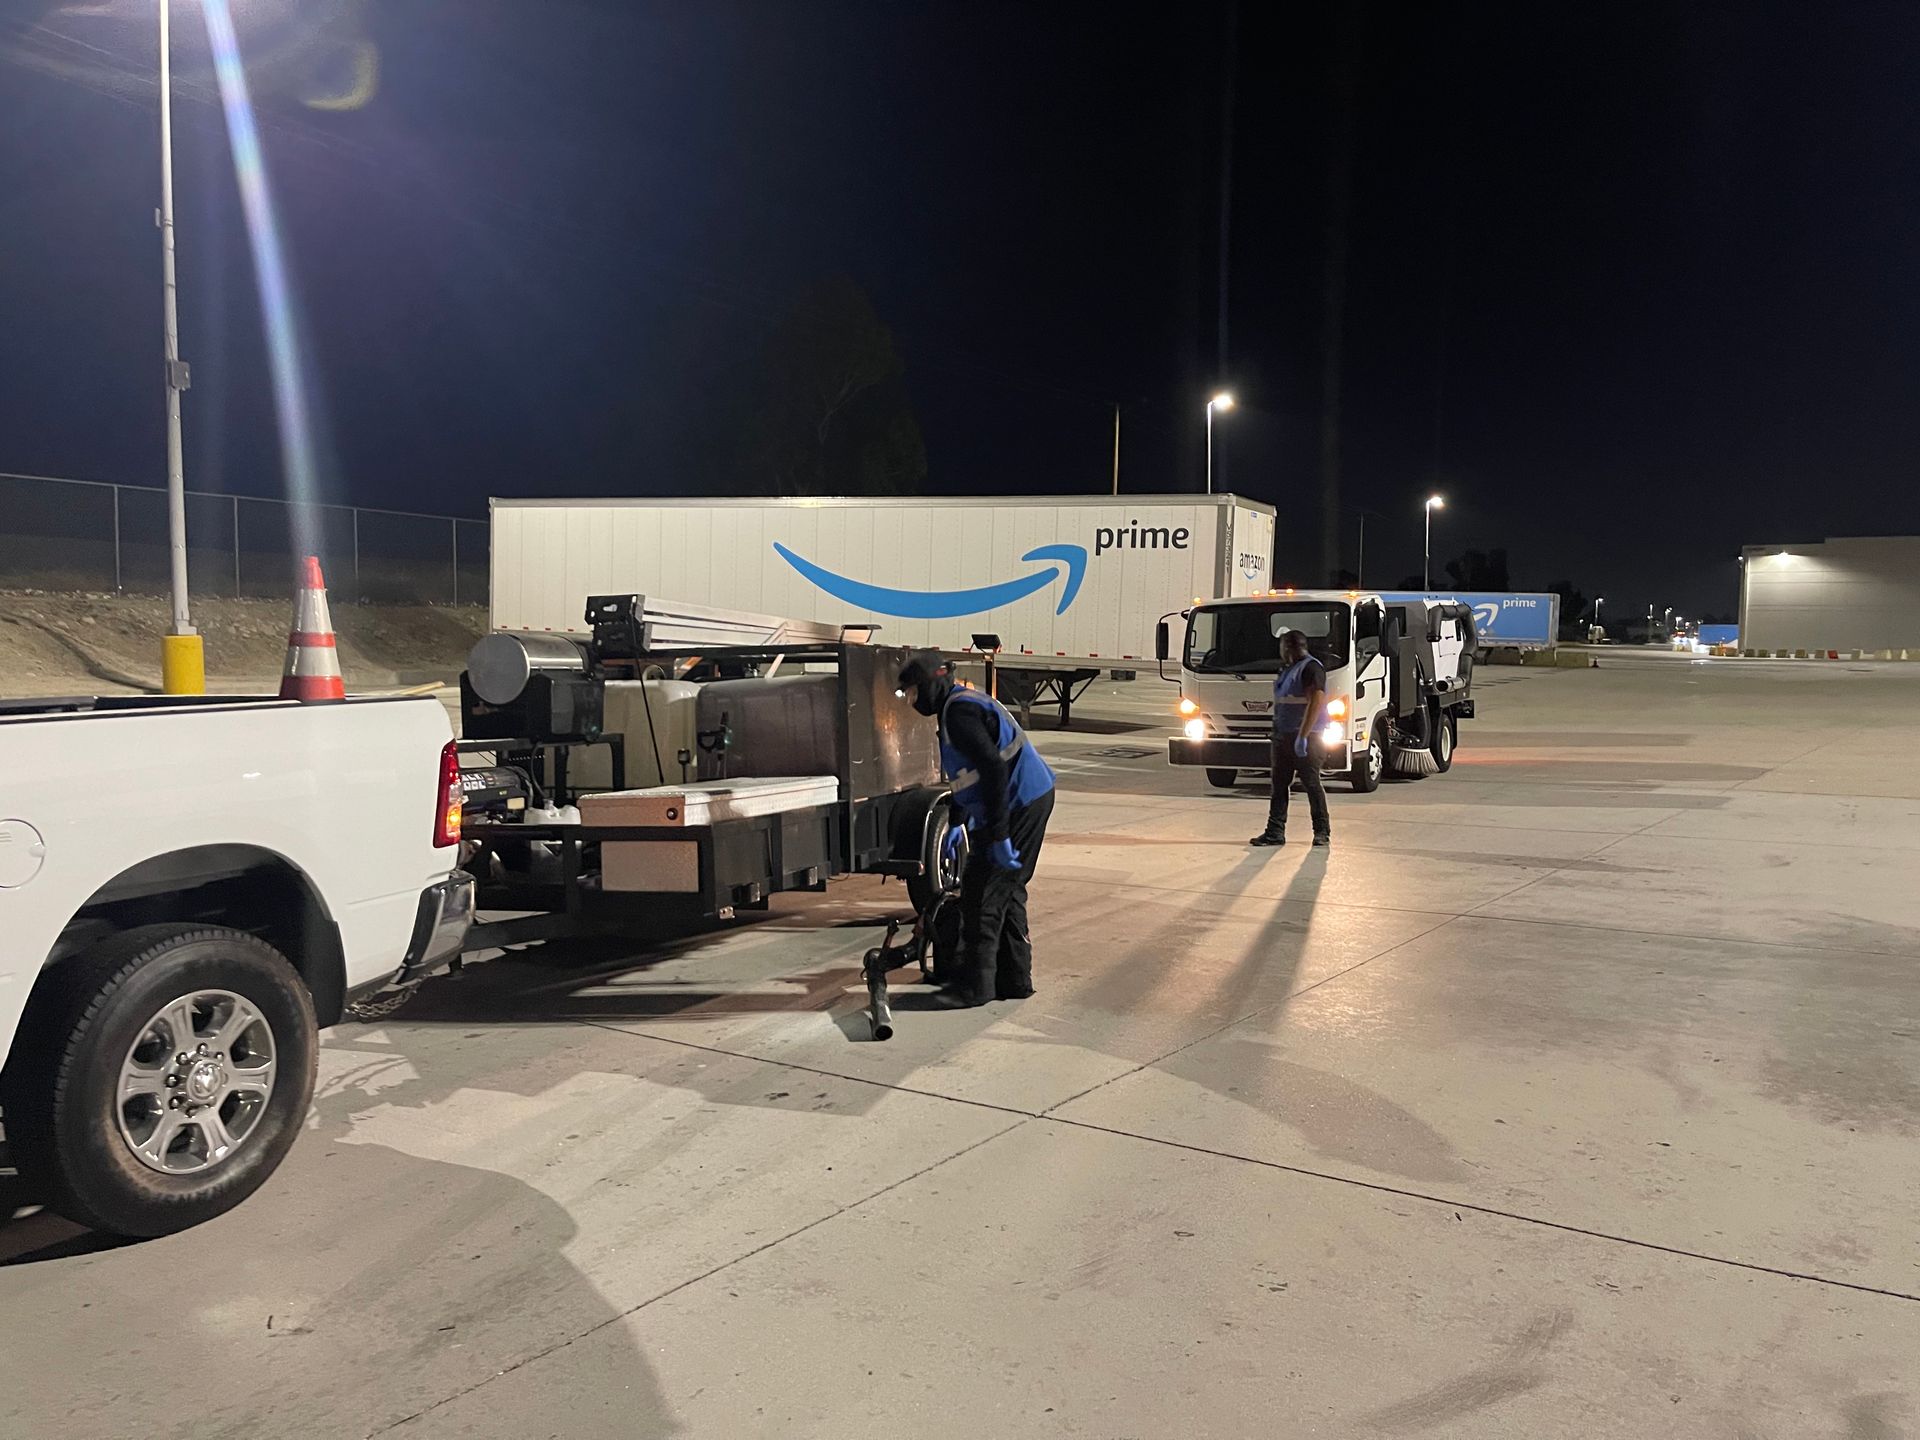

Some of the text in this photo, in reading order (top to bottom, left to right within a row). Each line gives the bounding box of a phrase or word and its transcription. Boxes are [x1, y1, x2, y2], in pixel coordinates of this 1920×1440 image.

[1096, 519, 1189, 556] prime
[1239, 552, 1265, 572] amazon
[1503, 597, 1537, 609] prime
